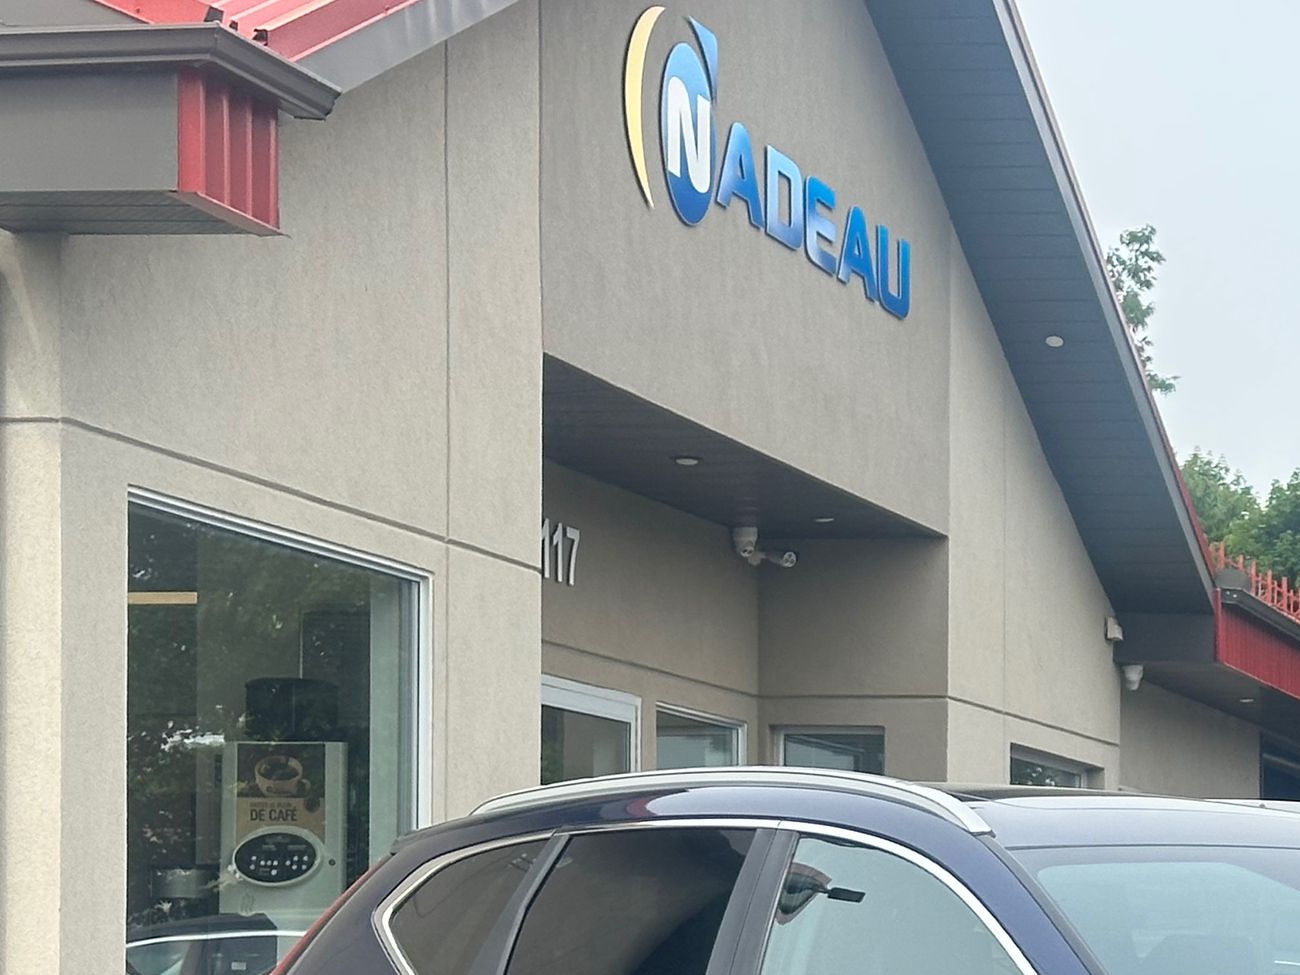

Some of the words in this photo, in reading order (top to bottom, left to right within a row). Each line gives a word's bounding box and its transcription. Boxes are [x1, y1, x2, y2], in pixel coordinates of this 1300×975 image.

[663, 75, 911, 320] NADEAU
[250, 808, 265, 822] DE
[268, 806, 298, 822] CAFÉ
